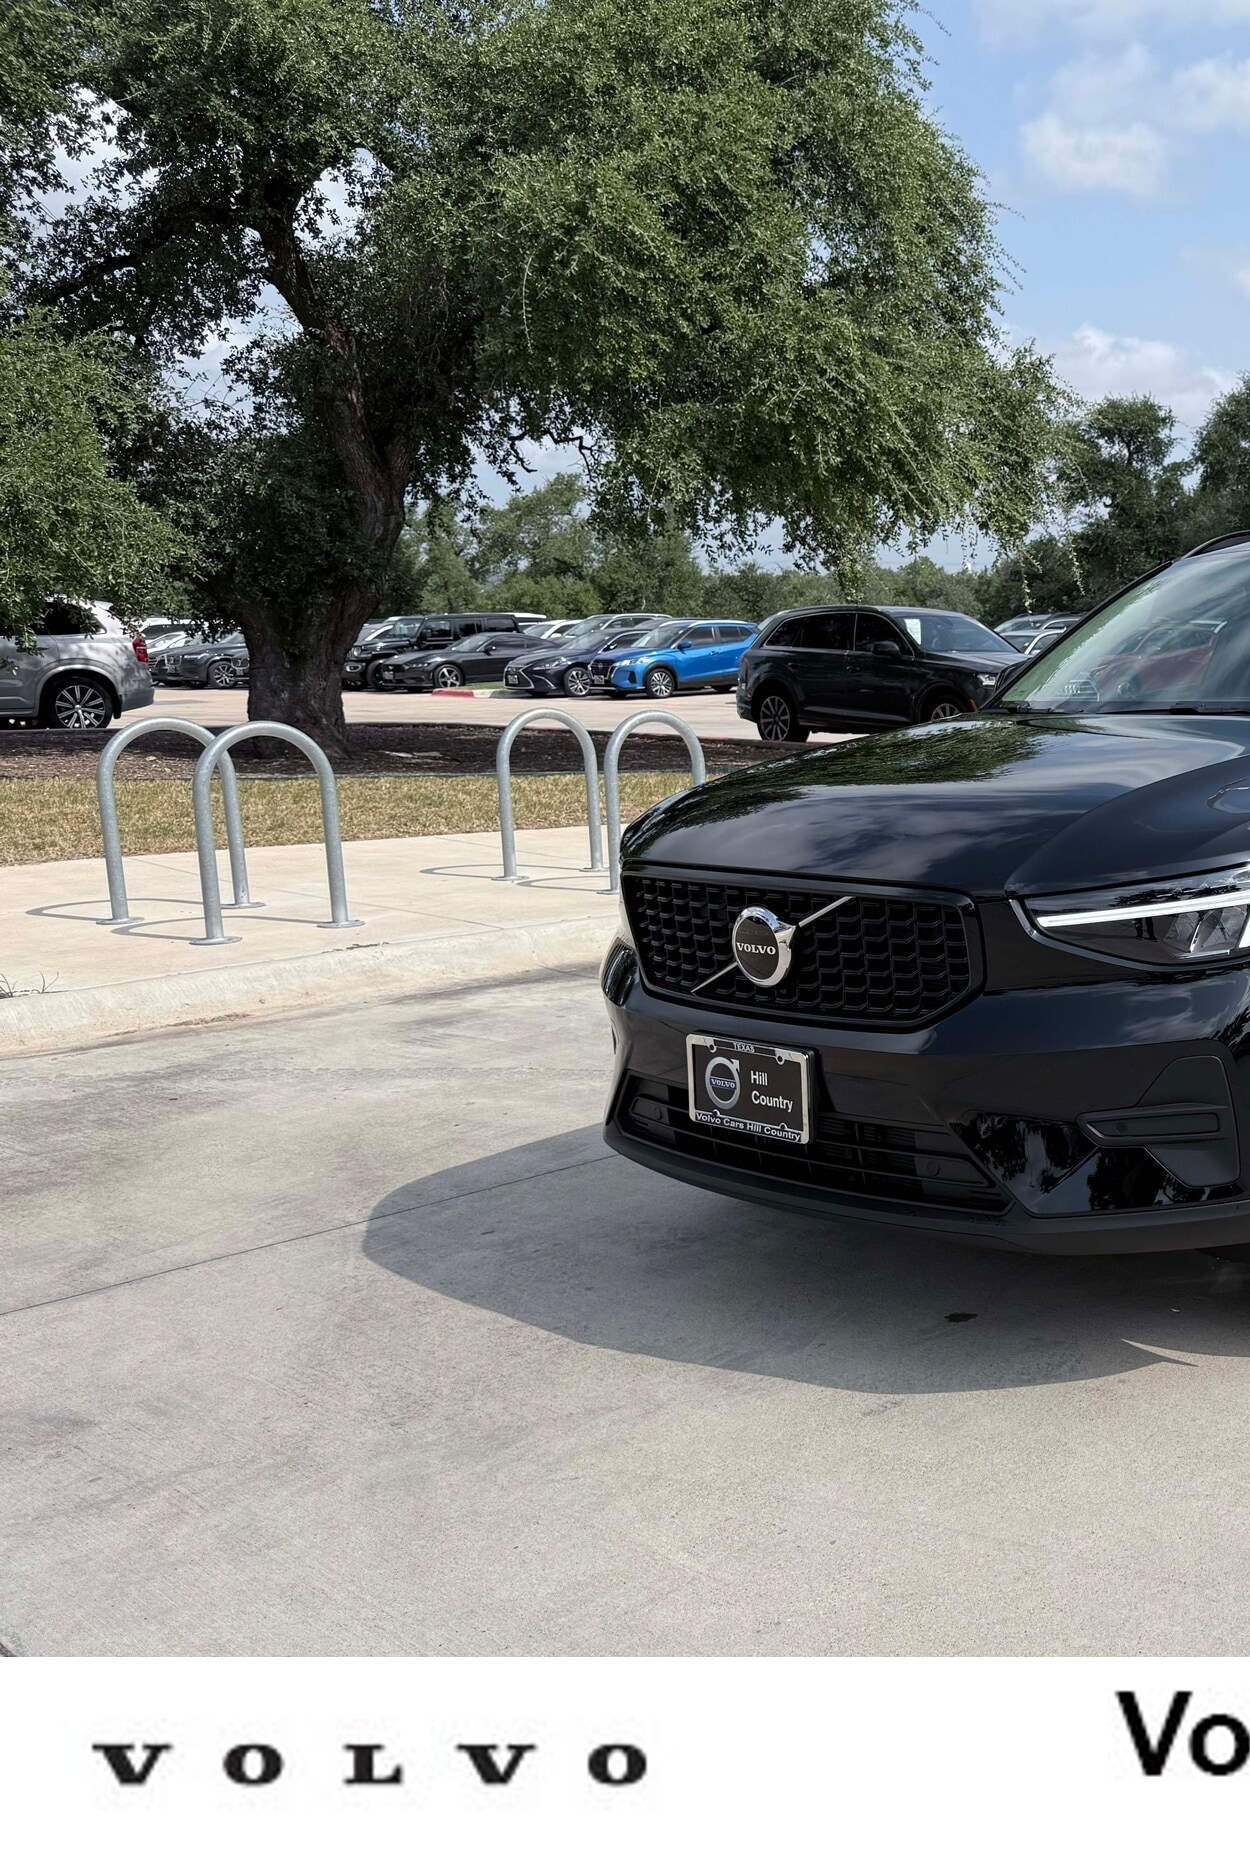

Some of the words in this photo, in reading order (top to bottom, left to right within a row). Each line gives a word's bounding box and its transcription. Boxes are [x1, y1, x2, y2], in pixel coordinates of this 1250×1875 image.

[736, 942, 776, 955] VOLVO
[732, 1042, 755, 1053] TEXAS
[711, 1078, 736, 1089] VOLVO
[750, 1070, 768, 1086] Hill
[751, 1090, 793, 1112] Country
[696, 1112, 721, 1124] Volvo
[723, 1118, 745, 1129] Cars
[746, 1124, 762, 1133] Hill
[764, 1127, 801, 1141] Country
